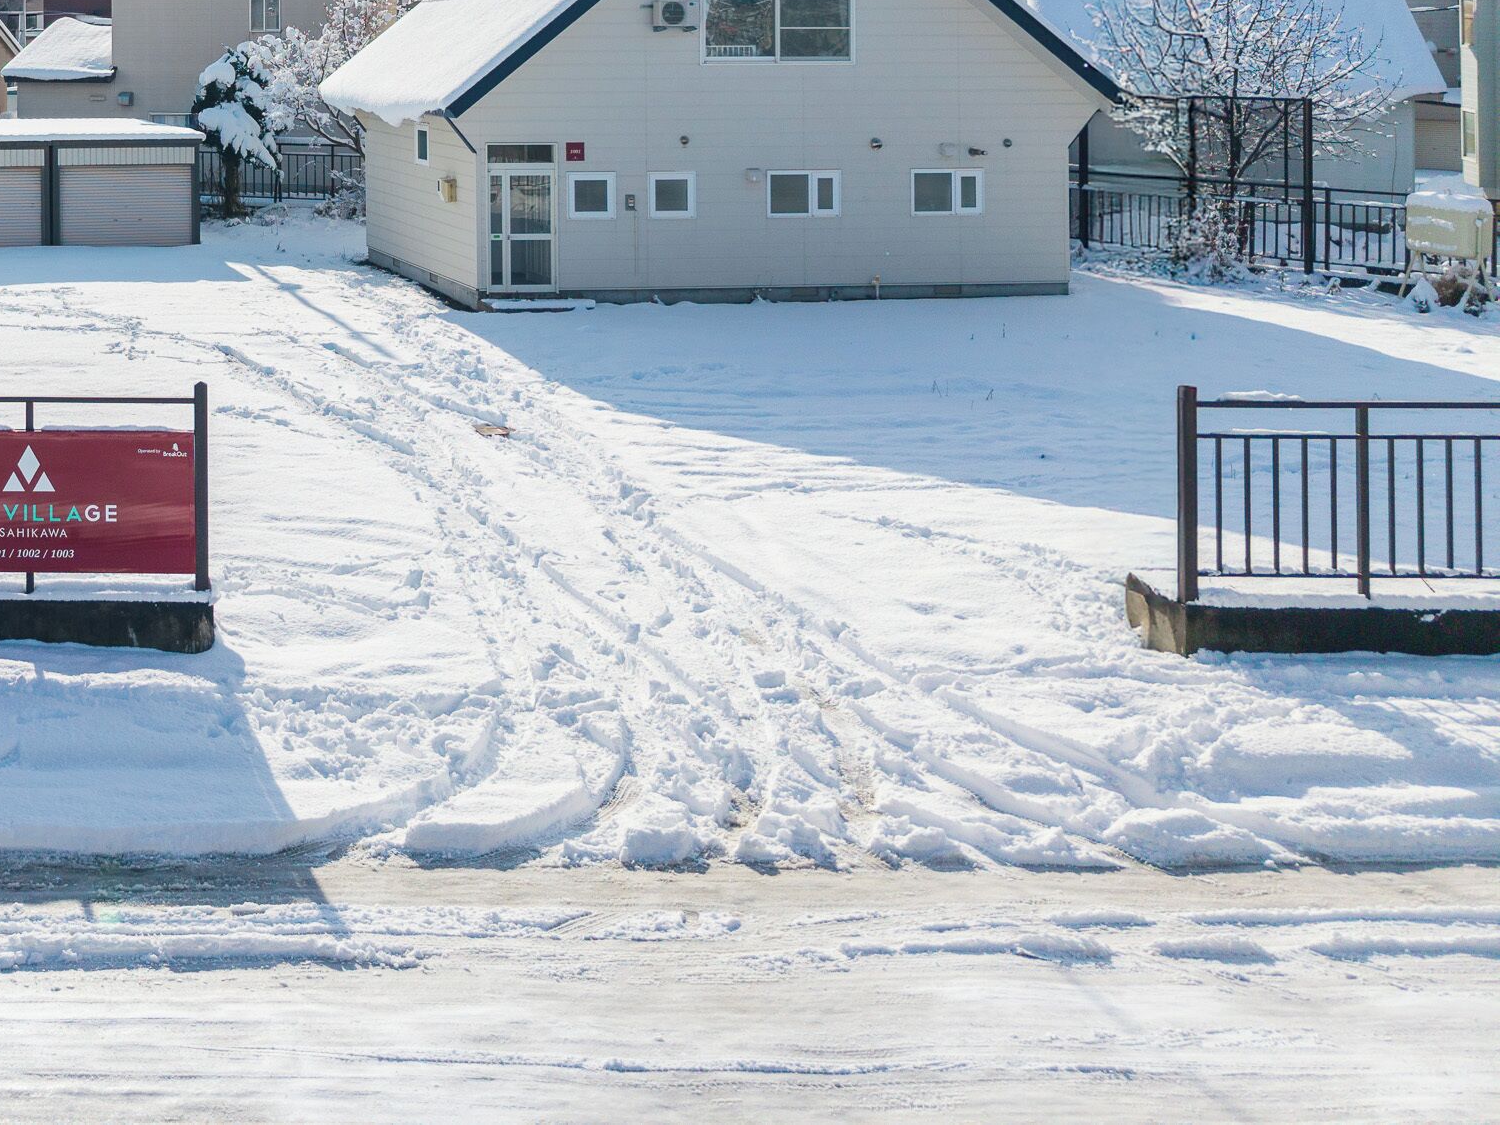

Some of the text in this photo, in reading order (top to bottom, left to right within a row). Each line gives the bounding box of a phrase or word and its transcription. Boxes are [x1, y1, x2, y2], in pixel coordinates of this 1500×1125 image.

[3, 504, 118, 523] VILLAGE
[17, 549, 41, 559] 1002
[50, 549, 75, 559] 1003
